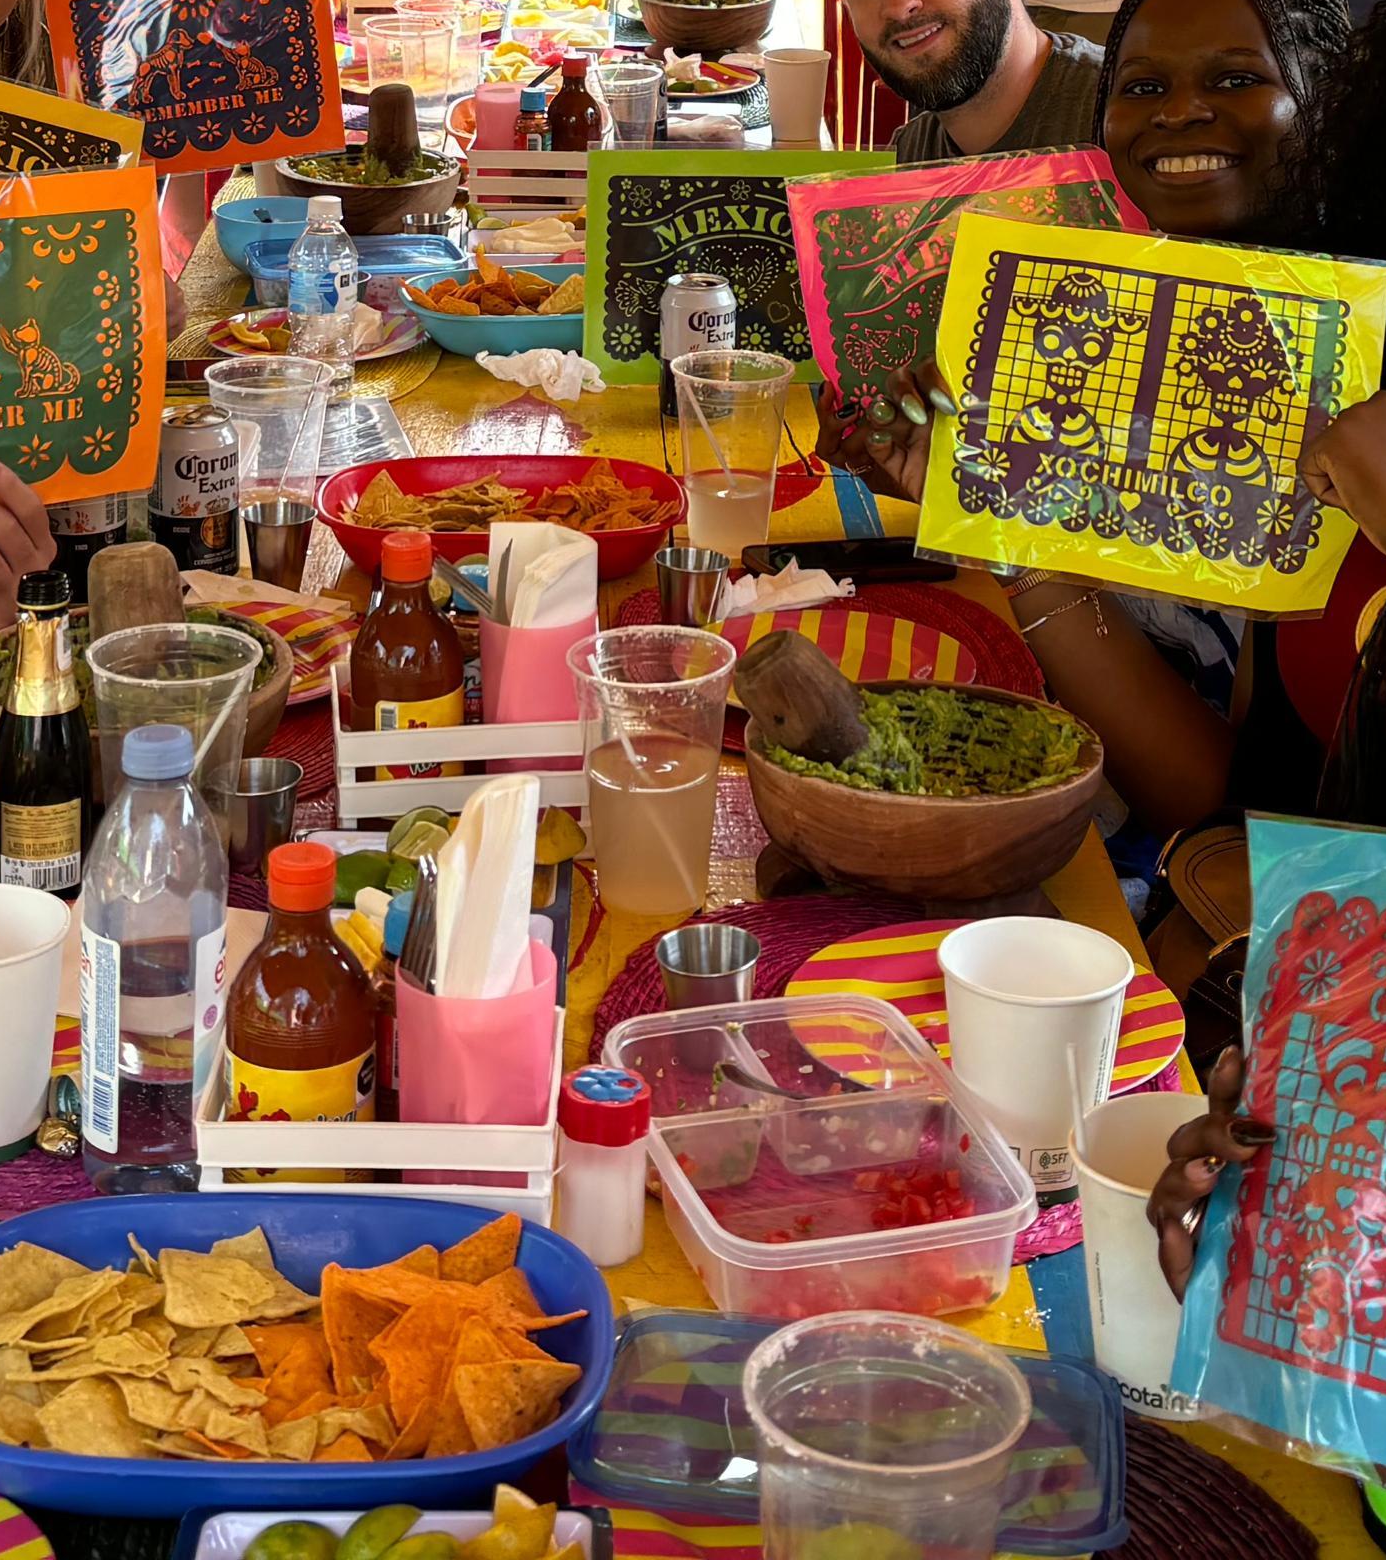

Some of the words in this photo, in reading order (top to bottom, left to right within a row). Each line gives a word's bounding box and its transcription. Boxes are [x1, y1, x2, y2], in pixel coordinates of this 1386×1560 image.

[254, 87, 284, 105] ME
[652, 203, 794, 253] MEXIC
[688, 311, 736, 334] Coron
[41, 397, 85, 424] ME
[174, 452, 239, 483] Coron
[1037, 452, 1232, 508] XOCHIMILCO
[199, 477, 235, 494] Extra
